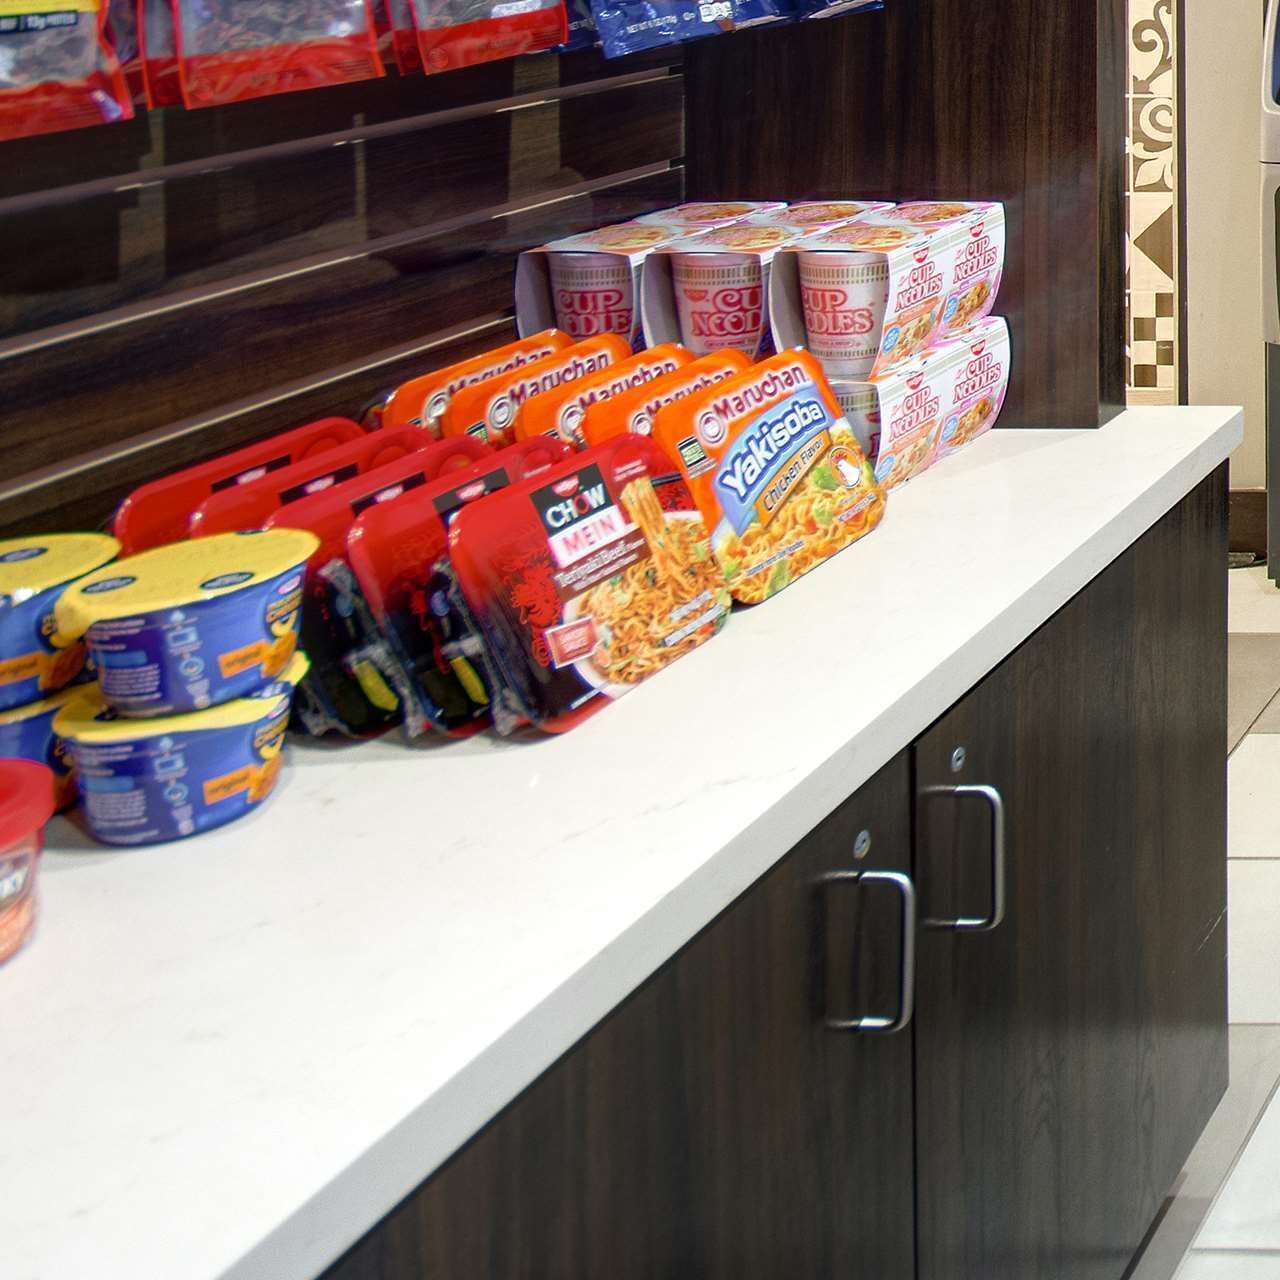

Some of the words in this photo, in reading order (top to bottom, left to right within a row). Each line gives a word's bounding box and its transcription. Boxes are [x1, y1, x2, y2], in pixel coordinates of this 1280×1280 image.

[953, 246, 998, 283] NOODLES
[965, 235, 990, 261] CUP
[895, 274, 943, 313] NOODLES
[908, 260, 936, 289] CUP
[557, 288, 622, 312] CUP
[712, 287, 762, 313] CU
[691, 310, 762, 337] NOOD
[508, 350, 609, 406] Maruchan
[953, 363, 1001, 405] NOODLES
[965, 352, 992, 380] CUP
[713, 365, 807, 420] Maruchan
[903, 385, 932, 415] CUP
[889, 398, 940, 443] NOODLES
[721, 399, 825, 501] Yakisoba
[762, 461, 802, 512] Chicken
[799, 437, 826, 468] Flavor
[545, 483, 606, 528] CHOW
[562, 513, 618, 556] MEIN
